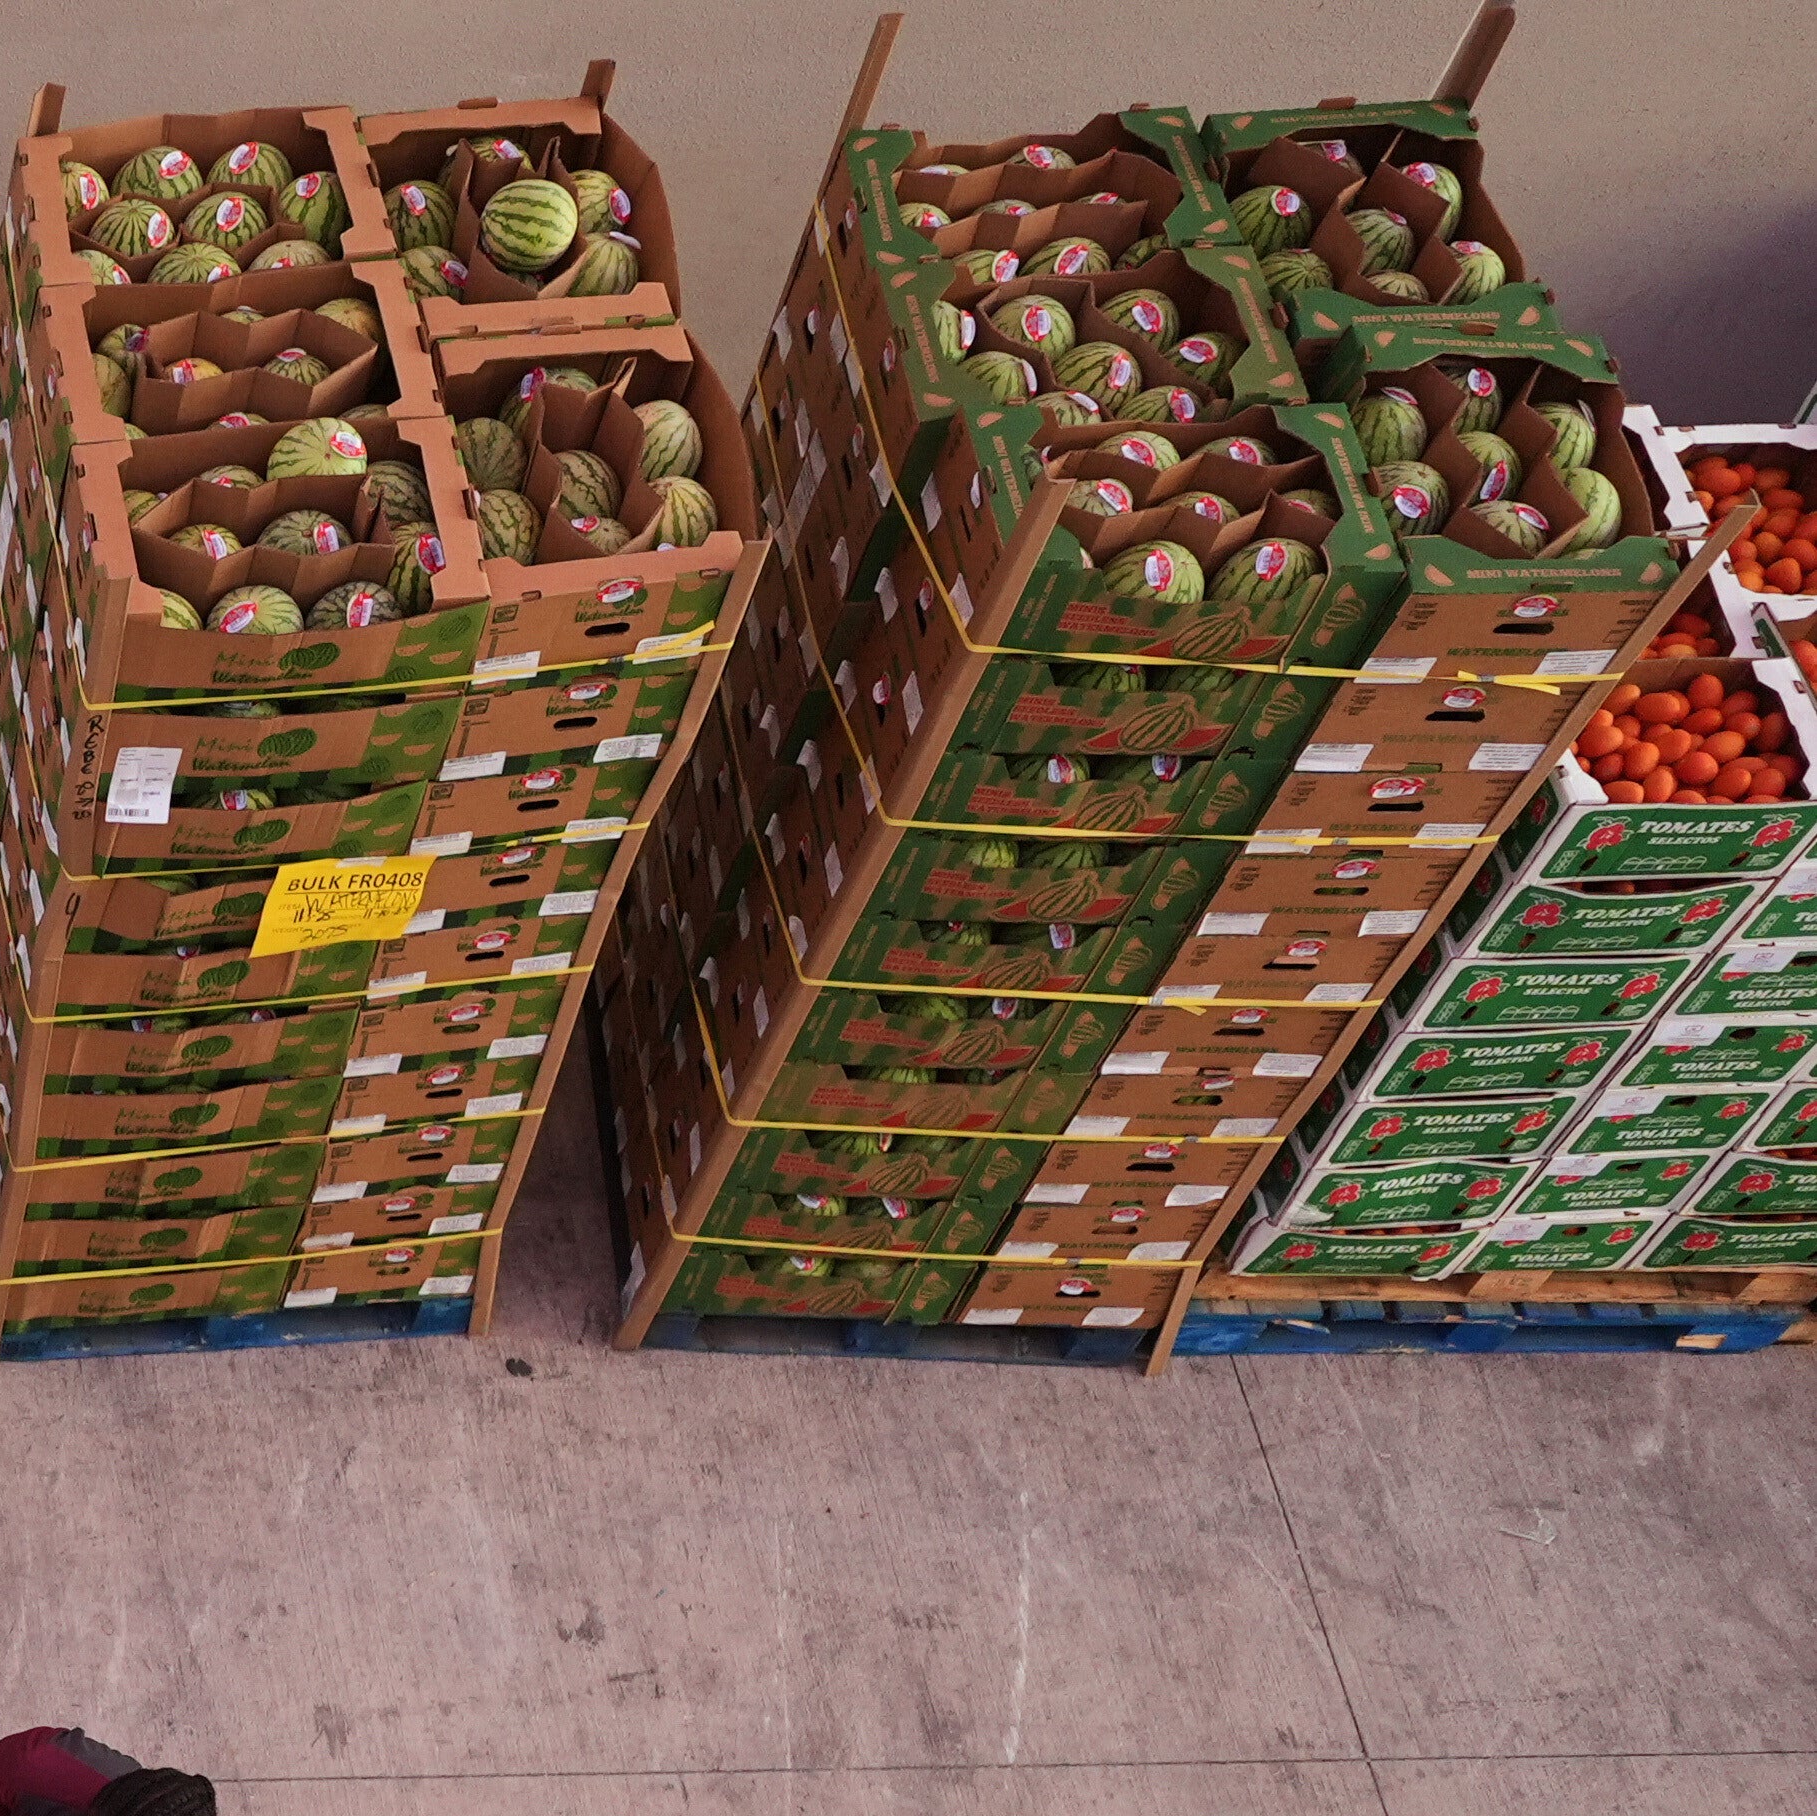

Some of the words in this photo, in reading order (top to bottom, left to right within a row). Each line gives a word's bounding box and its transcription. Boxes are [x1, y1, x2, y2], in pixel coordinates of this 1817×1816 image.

[1351, 312, 1388, 326] MINI
[1390, 311, 1501, 323] WATERMELONS
[1331, 436, 1366, 509] WATERMELONS
[1467, 569, 1503, 579] MINI
[1505, 568, 1622, 578] WATERMELONS
[574, 606, 644, 623] Watermelon
[1067, 602, 1110, 614] MINIS
[1057, 621, 1159, 637] WATERMELONS
[192, 756, 292, 771] Watermelon
[1635, 820, 1756, 834] TOMATES
[1646, 836, 1722, 846] SELECTOS
[287, 874, 343, 892] BULK
[347, 871, 424, 889] FR0408
[1571, 904, 1687, 920] TOMATES
[1580, 918, 1654, 929] SELECTOS
[1513, 972, 1623, 987] TOMATES
[1523, 987, 1593, 996] SELECTOS
[1725, 987, 1817, 1000] TOMATES
[1460, 1042, 1566, 1058] TOMATES
[1470, 1054, 1537, 1067] SELECTOS
[1668, 1060, 1762, 1073] TOMATES
[1676, 1071, 1734, 1080] SELECTOS
[1412, 1112, 1516, 1126] TOMATES
[1421, 1125, 1488, 1135] SELECTOS
[1615, 1127, 1706, 1141] TOMATES
[1370, 1172, 1466, 1193] TOMATES
[1378, 1185, 1440, 1199] SELECTOS
[1561, 1188, 1648, 1201] TOMATES
[1324, 1244, 1422, 1255] TOMATES
[1508, 1251, 1595, 1262] TOMATES
